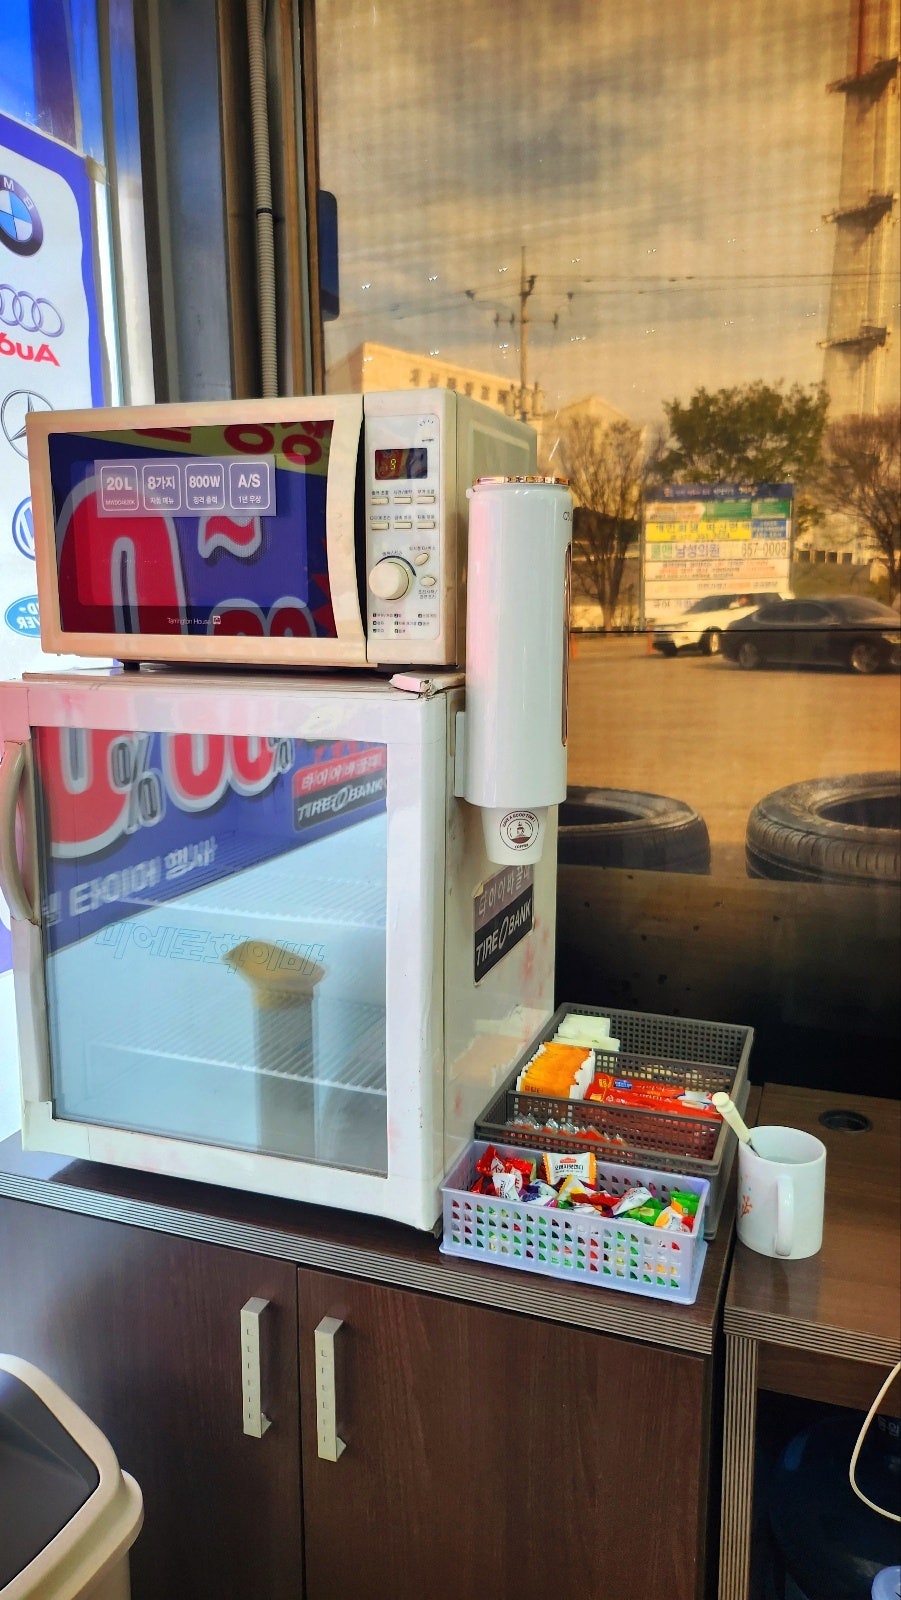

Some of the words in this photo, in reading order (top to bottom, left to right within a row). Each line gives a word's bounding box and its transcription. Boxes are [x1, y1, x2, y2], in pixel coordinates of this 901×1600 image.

[106, 476, 133, 491] 20L
[147, 475, 176, 490] 8가지
[189, 474, 221, 489] 800W
[238, 473, 261, 488] A/S
[162, 496, 175, 505] 메뉴
[192, 496, 205, 505] 정격
[206, 496, 218, 505] 출력
[238, 495, 248, 504] 1년
[249, 495, 262, 504] 무상
[297, 796, 332, 822] TIRE
[69, 856, 161, 917] 타이어
[475, 928, 499, 967] TIRE
[508, 898, 532, 936] BANK
[95, 922, 326, 976] 미에로화이바
